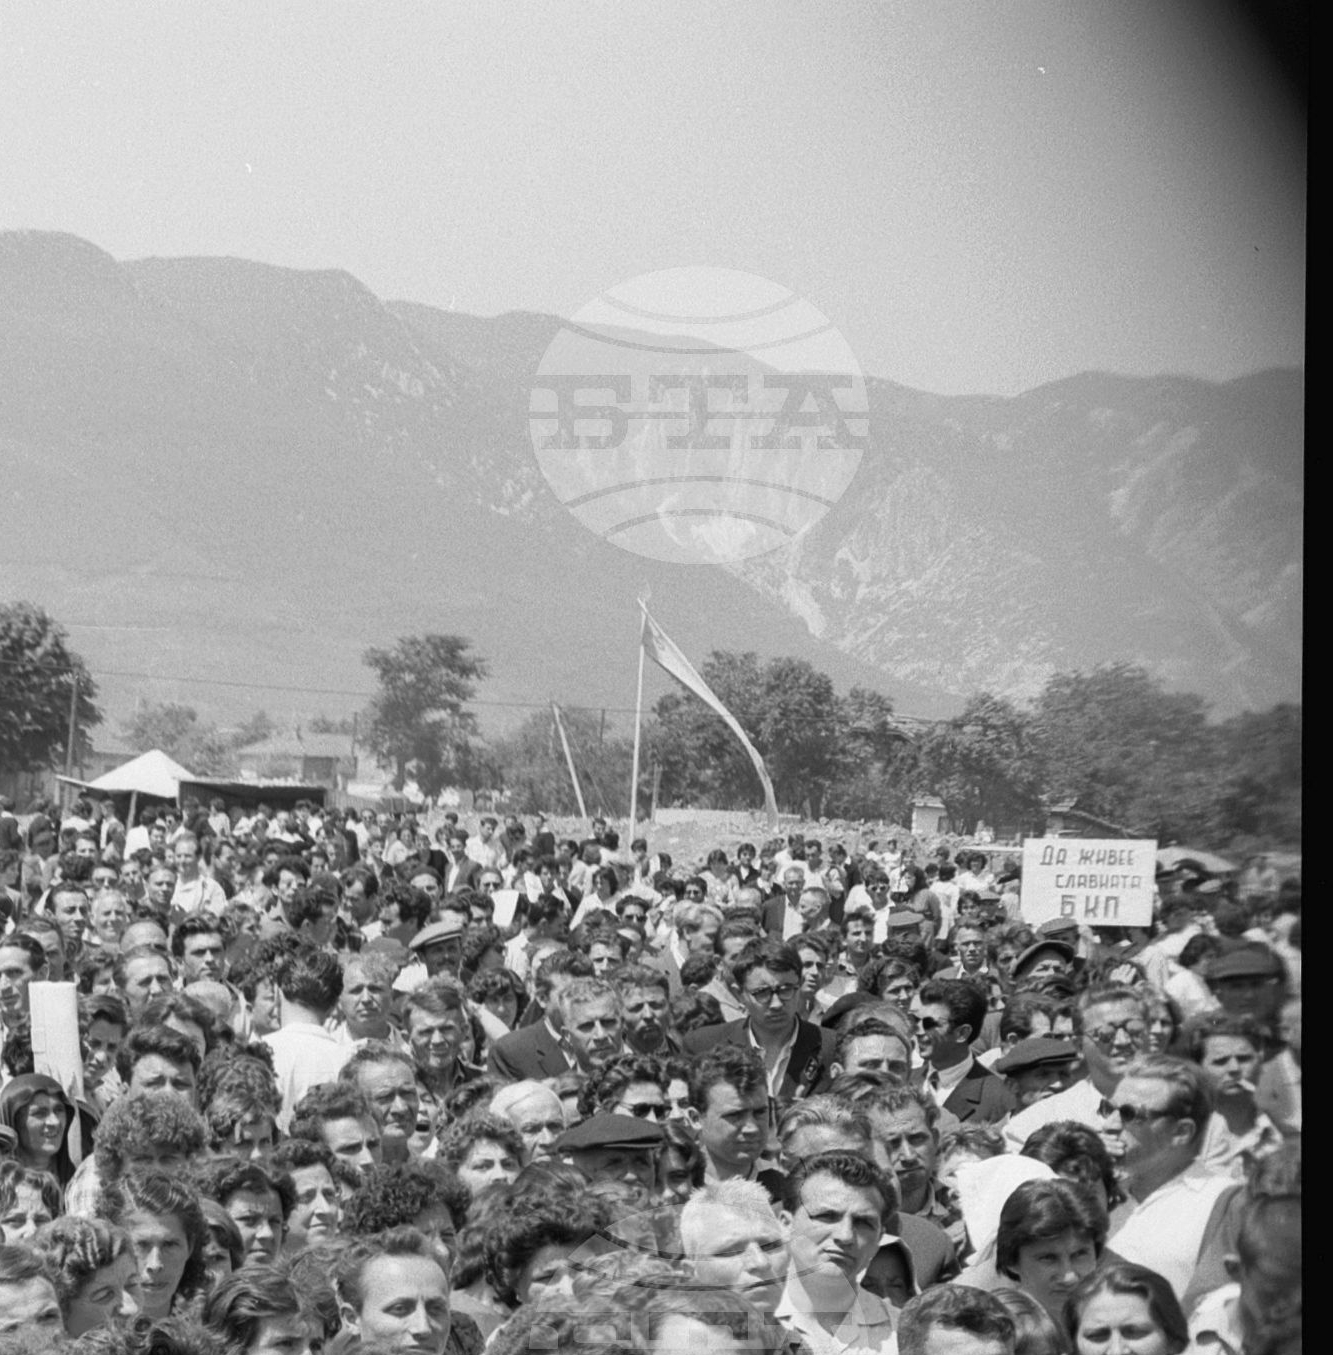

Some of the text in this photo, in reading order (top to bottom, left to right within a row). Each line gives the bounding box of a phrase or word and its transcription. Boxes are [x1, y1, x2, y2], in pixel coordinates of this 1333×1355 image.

[1078, 848, 1135, 866] ЖИВЕЕ
[1055, 873, 1142, 889] СЛАВНАТА
[1060, 894, 1120, 918] БКП
